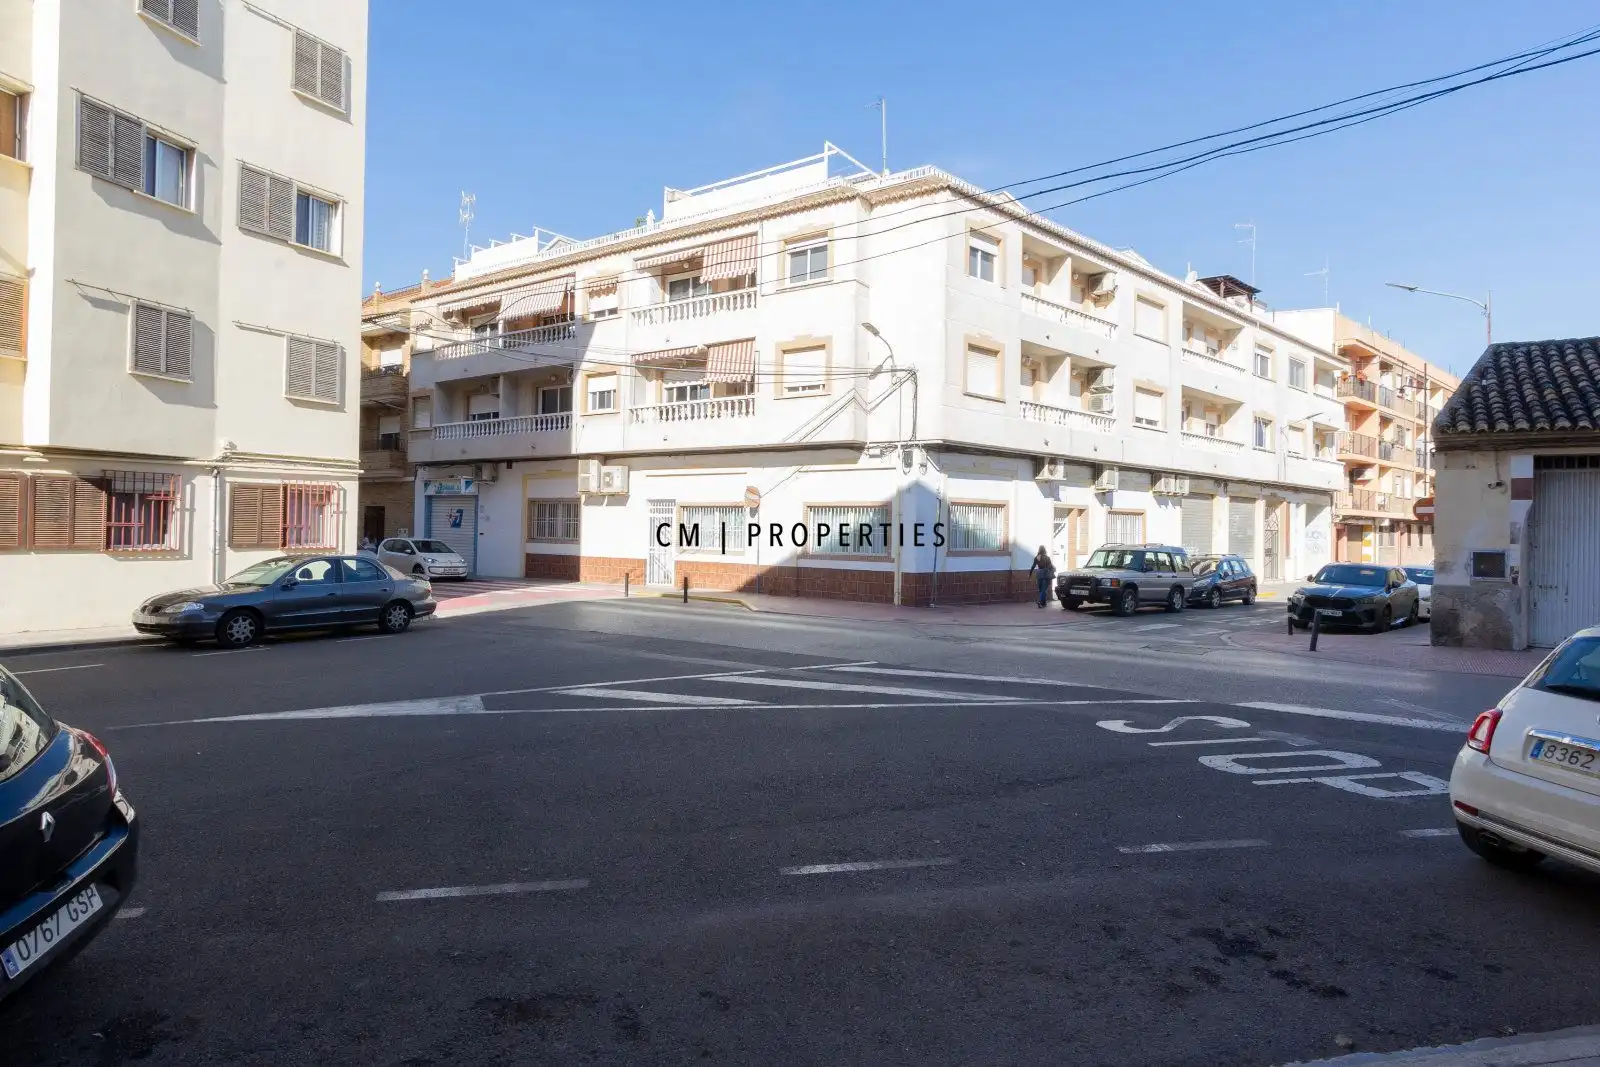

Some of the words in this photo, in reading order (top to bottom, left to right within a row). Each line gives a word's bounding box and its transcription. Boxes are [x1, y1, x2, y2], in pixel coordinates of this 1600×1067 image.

[1095, 715, 1451, 799] STOP
[1543, 744, 1595, 769] 8362
[15, 911, 61, 962] 0767
[65, 887, 97, 923] GSP
